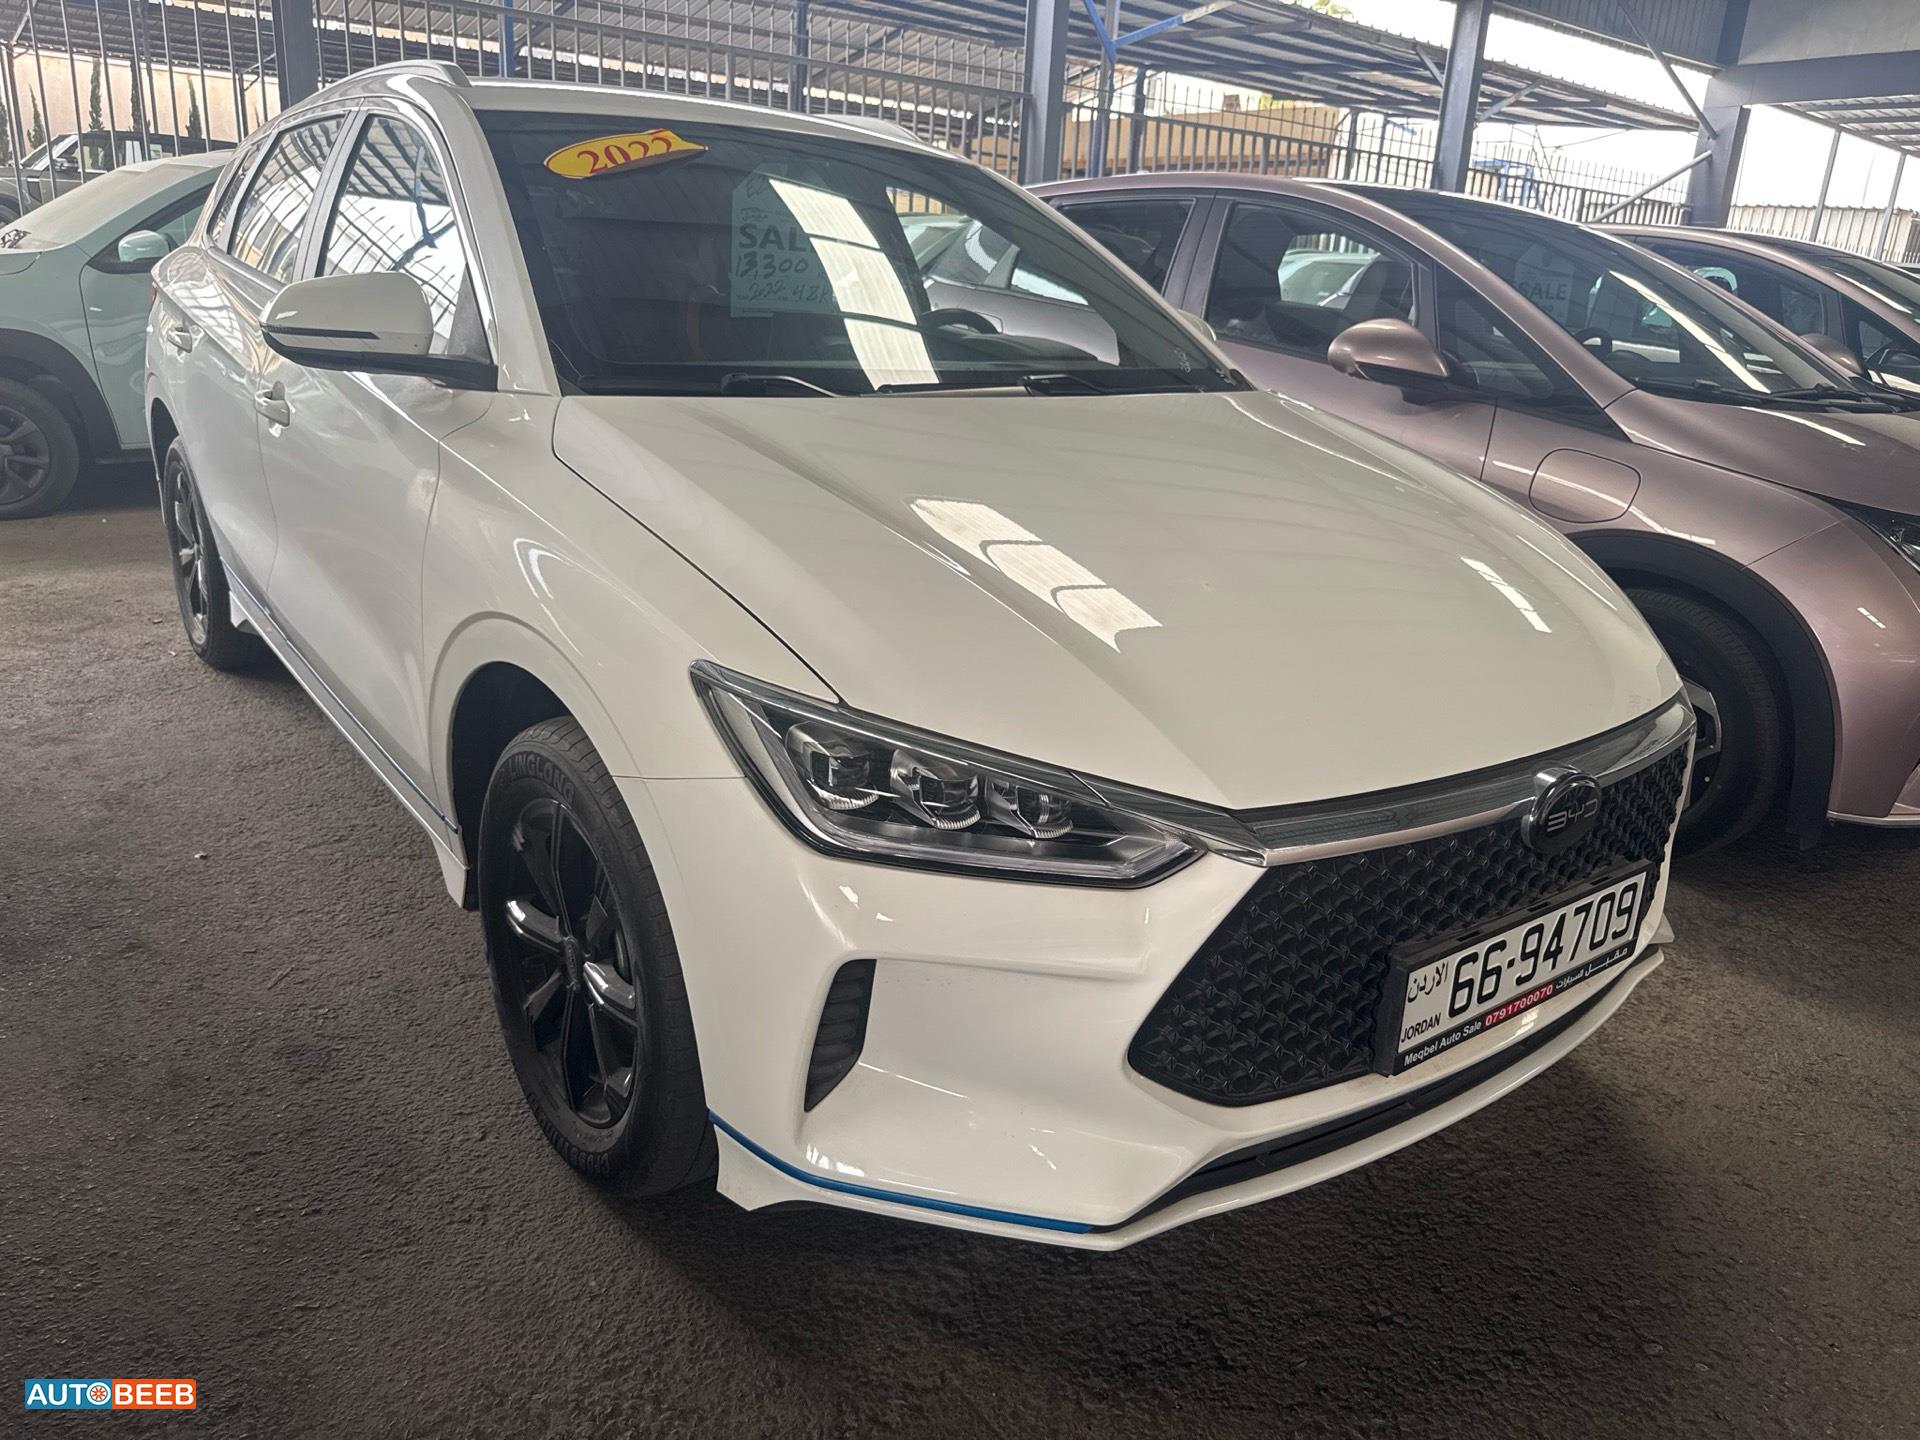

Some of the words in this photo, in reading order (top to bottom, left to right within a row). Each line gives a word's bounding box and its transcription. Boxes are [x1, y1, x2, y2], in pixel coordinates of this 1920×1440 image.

[738, 223, 816, 252] SAL
[1518, 281, 1568, 301] SALE
[1546, 798, 1598, 832] BYD
[1401, 1012, 1442, 1043] JORDAN
[1404, 1041, 1439, 1067] Meqbel
[1439, 1031, 1462, 1049] Auto
[1462, 1020, 1482, 1037] Sale
[1485, 984, 1554, 1026] 0791700070
